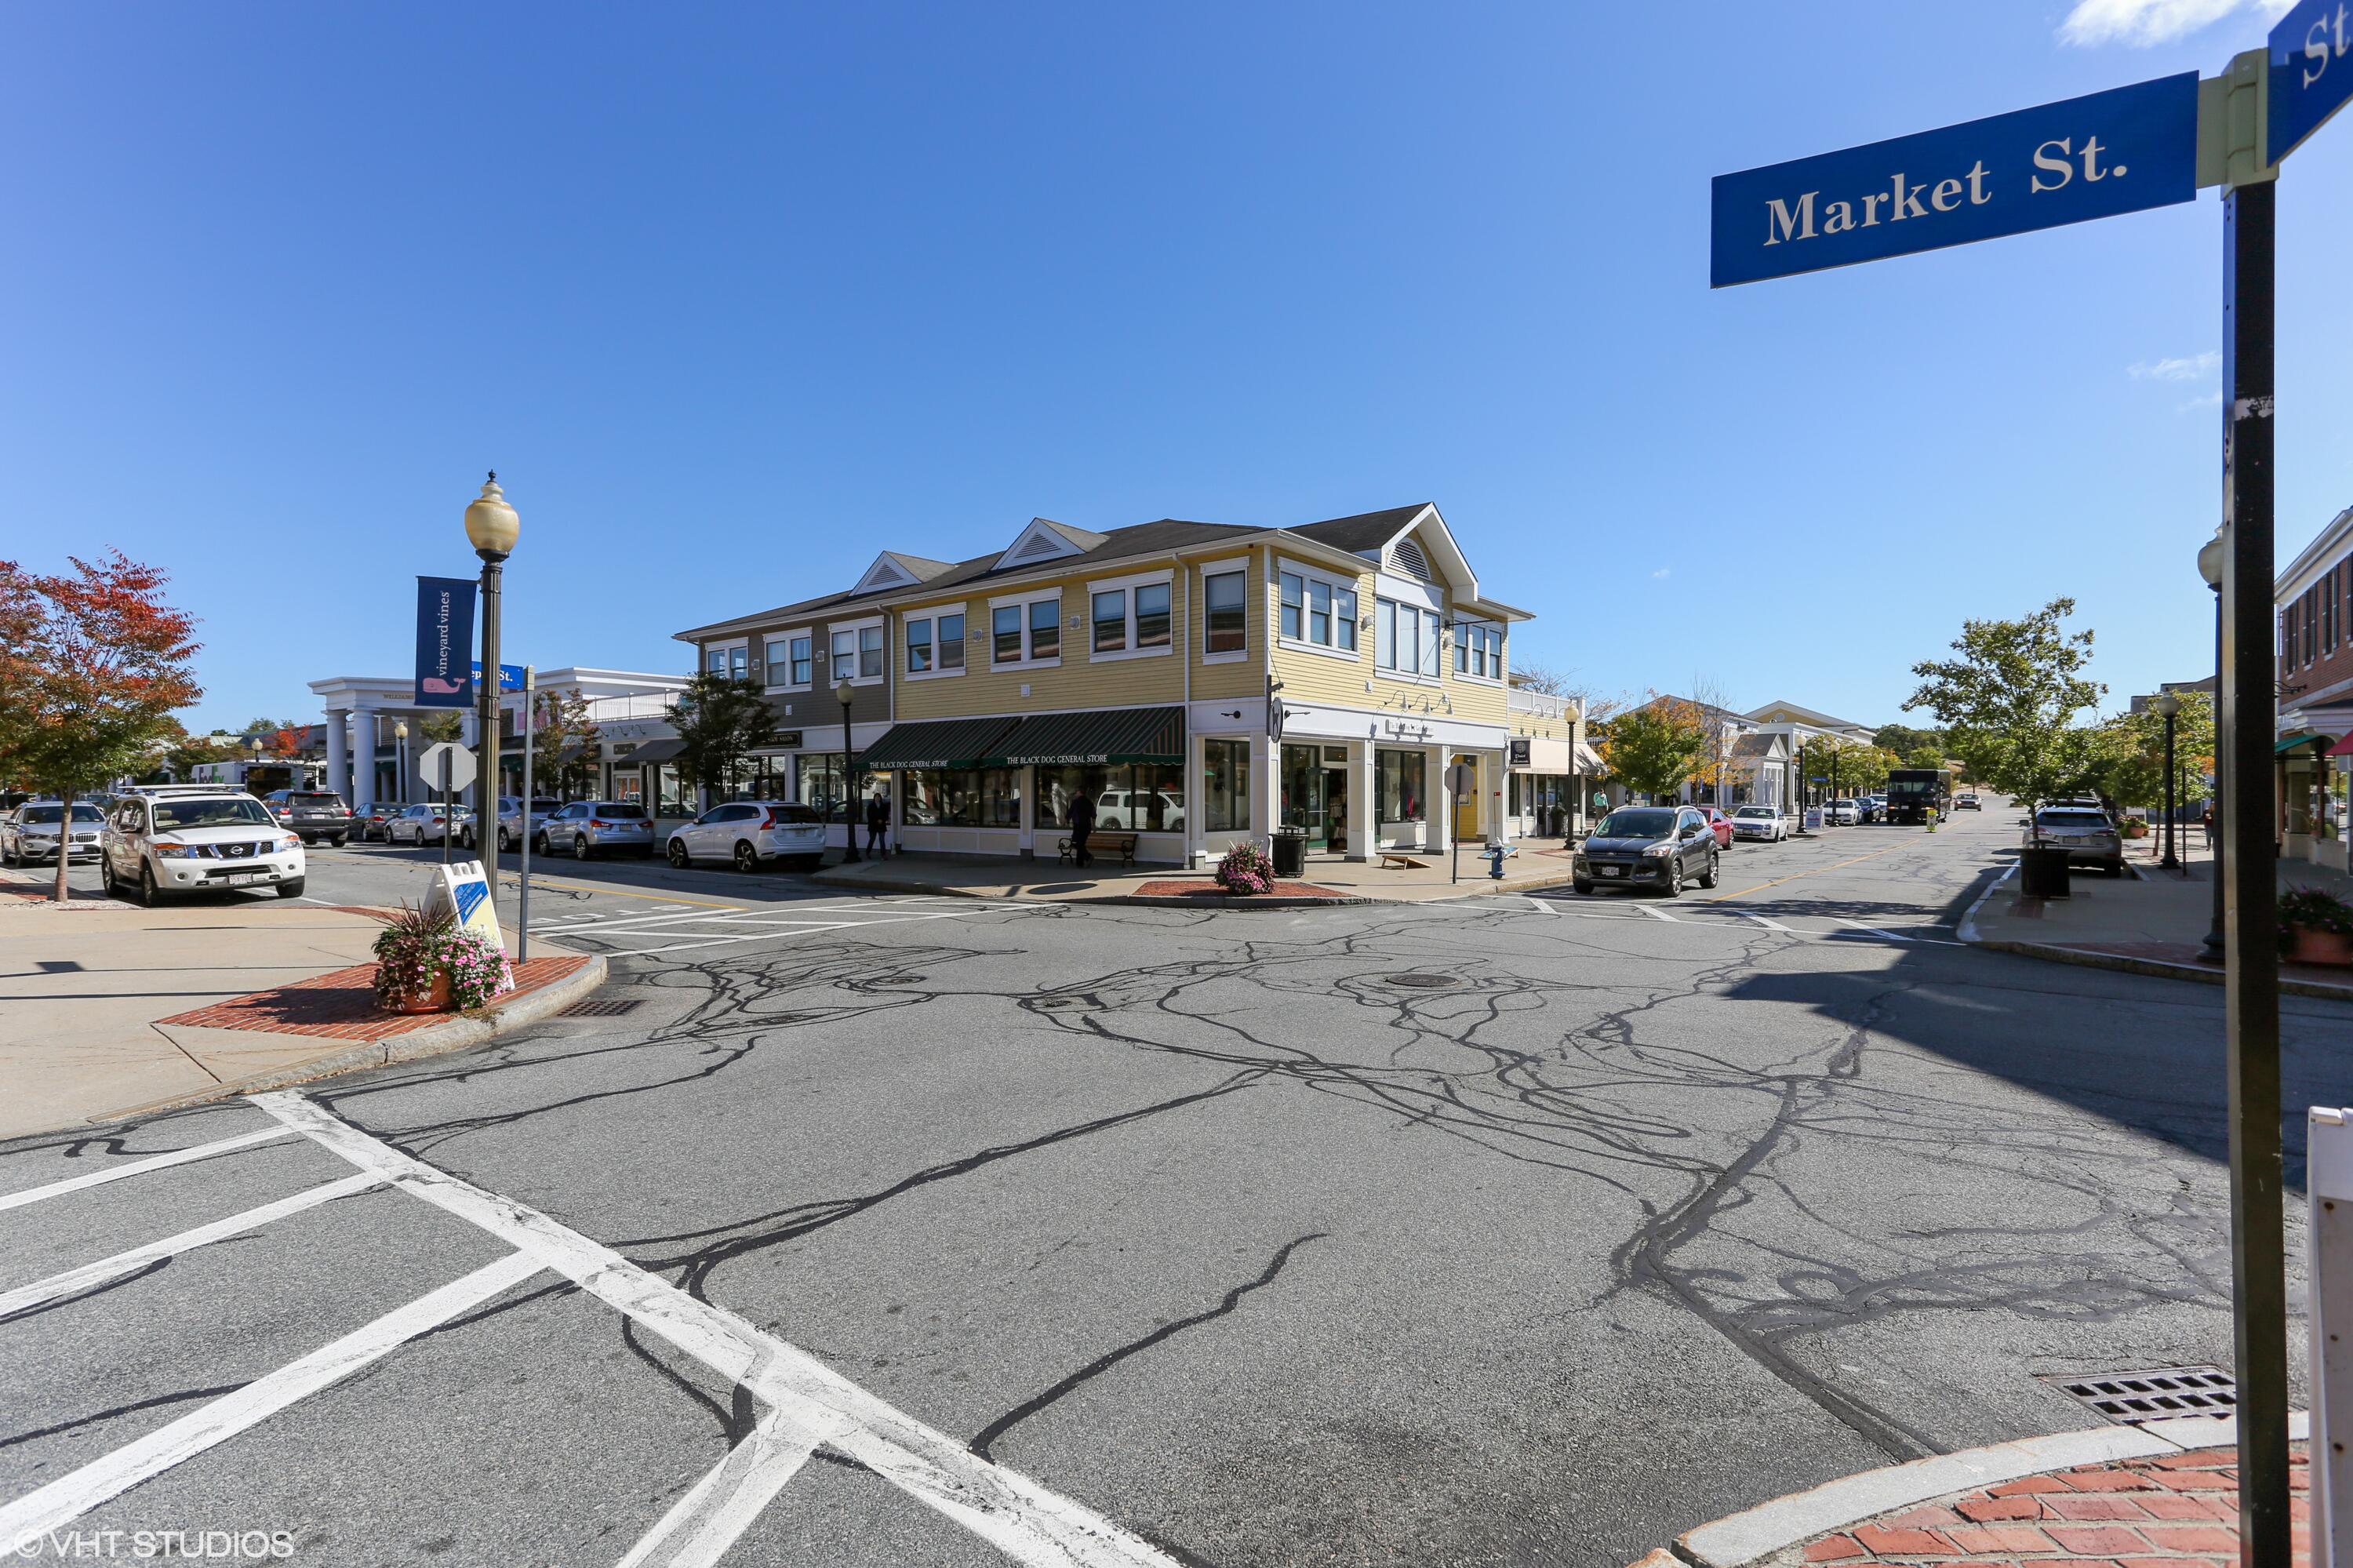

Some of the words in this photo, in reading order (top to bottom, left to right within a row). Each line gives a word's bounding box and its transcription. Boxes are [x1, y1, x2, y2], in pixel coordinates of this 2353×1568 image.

[1763, 160, 1992, 246] Market
[2031, 136, 2127, 194] St.
[438, 591, 450, 623] vines
[436, 625, 451, 676] vineyard
[1041, 755, 1056, 764] DOG
[1056, 755, 1086, 763] GENERAL
[1086, 754, 1107, 762] STORE
